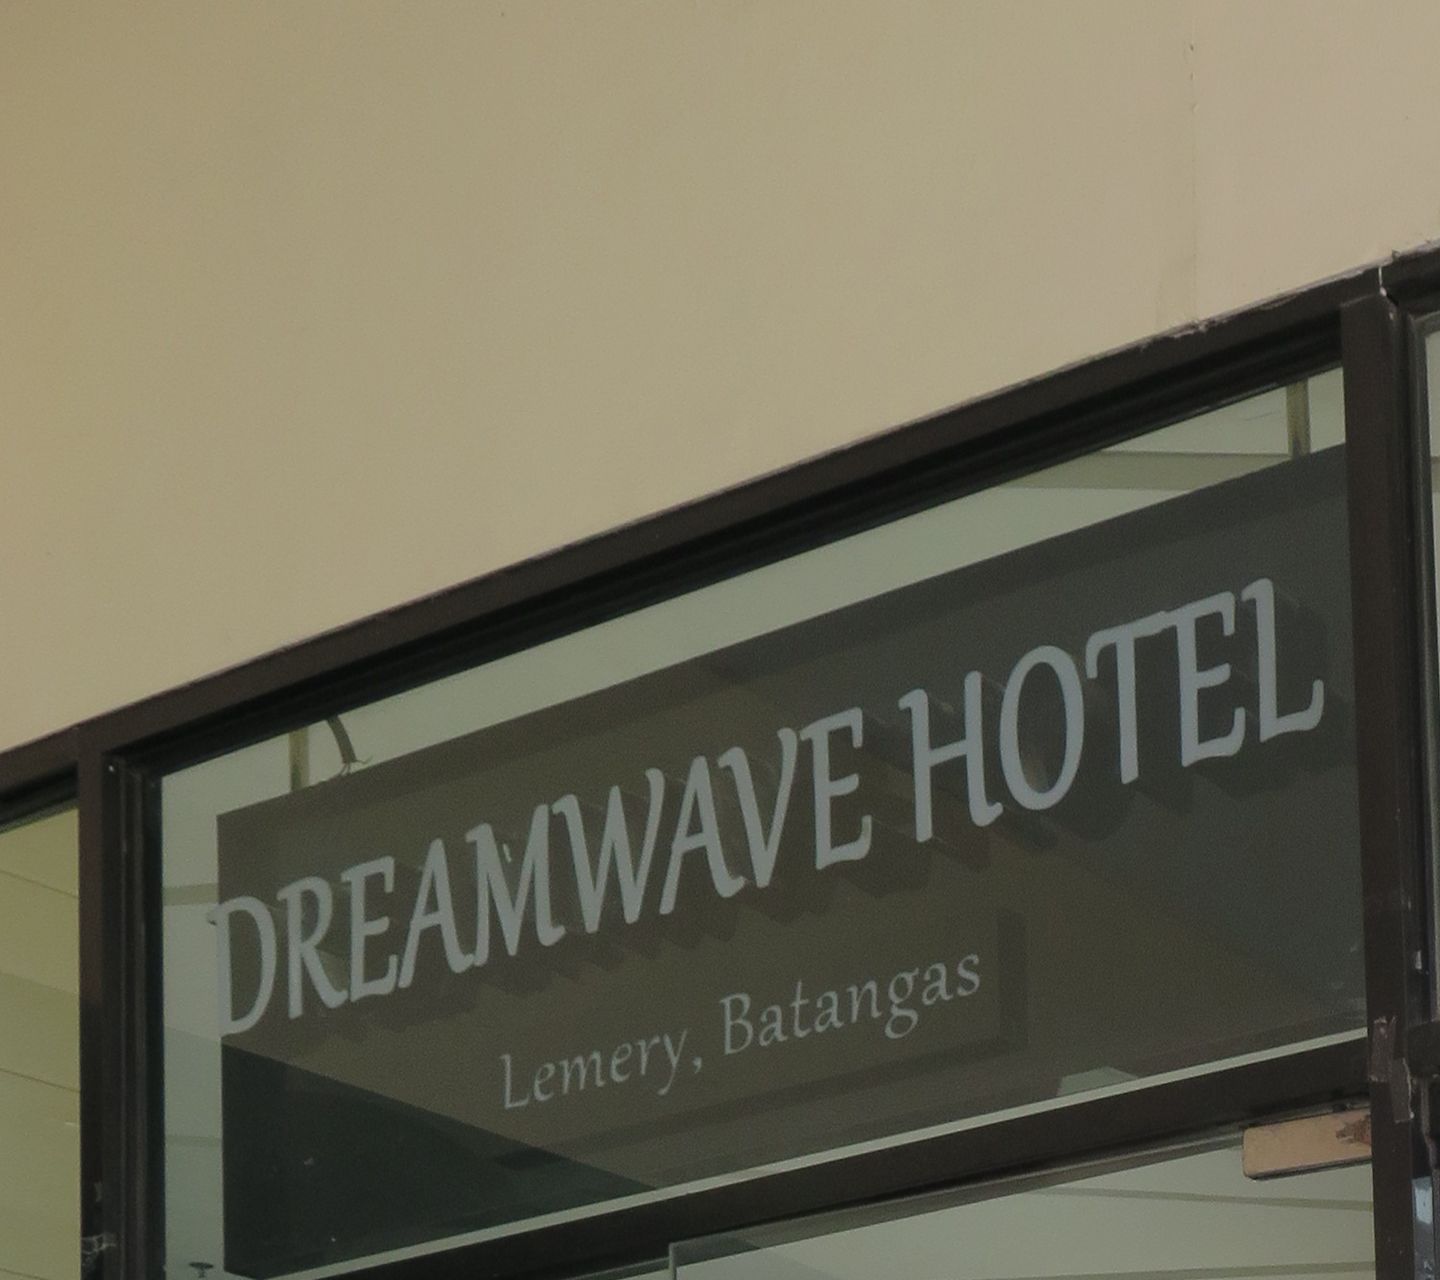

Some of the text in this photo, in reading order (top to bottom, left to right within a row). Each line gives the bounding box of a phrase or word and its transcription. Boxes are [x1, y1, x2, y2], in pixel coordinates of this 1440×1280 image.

[208, 578, 1324, 1037] DREAMWAVE HOTEL
[501, 950, 983, 1110] Lemery, Batangas
